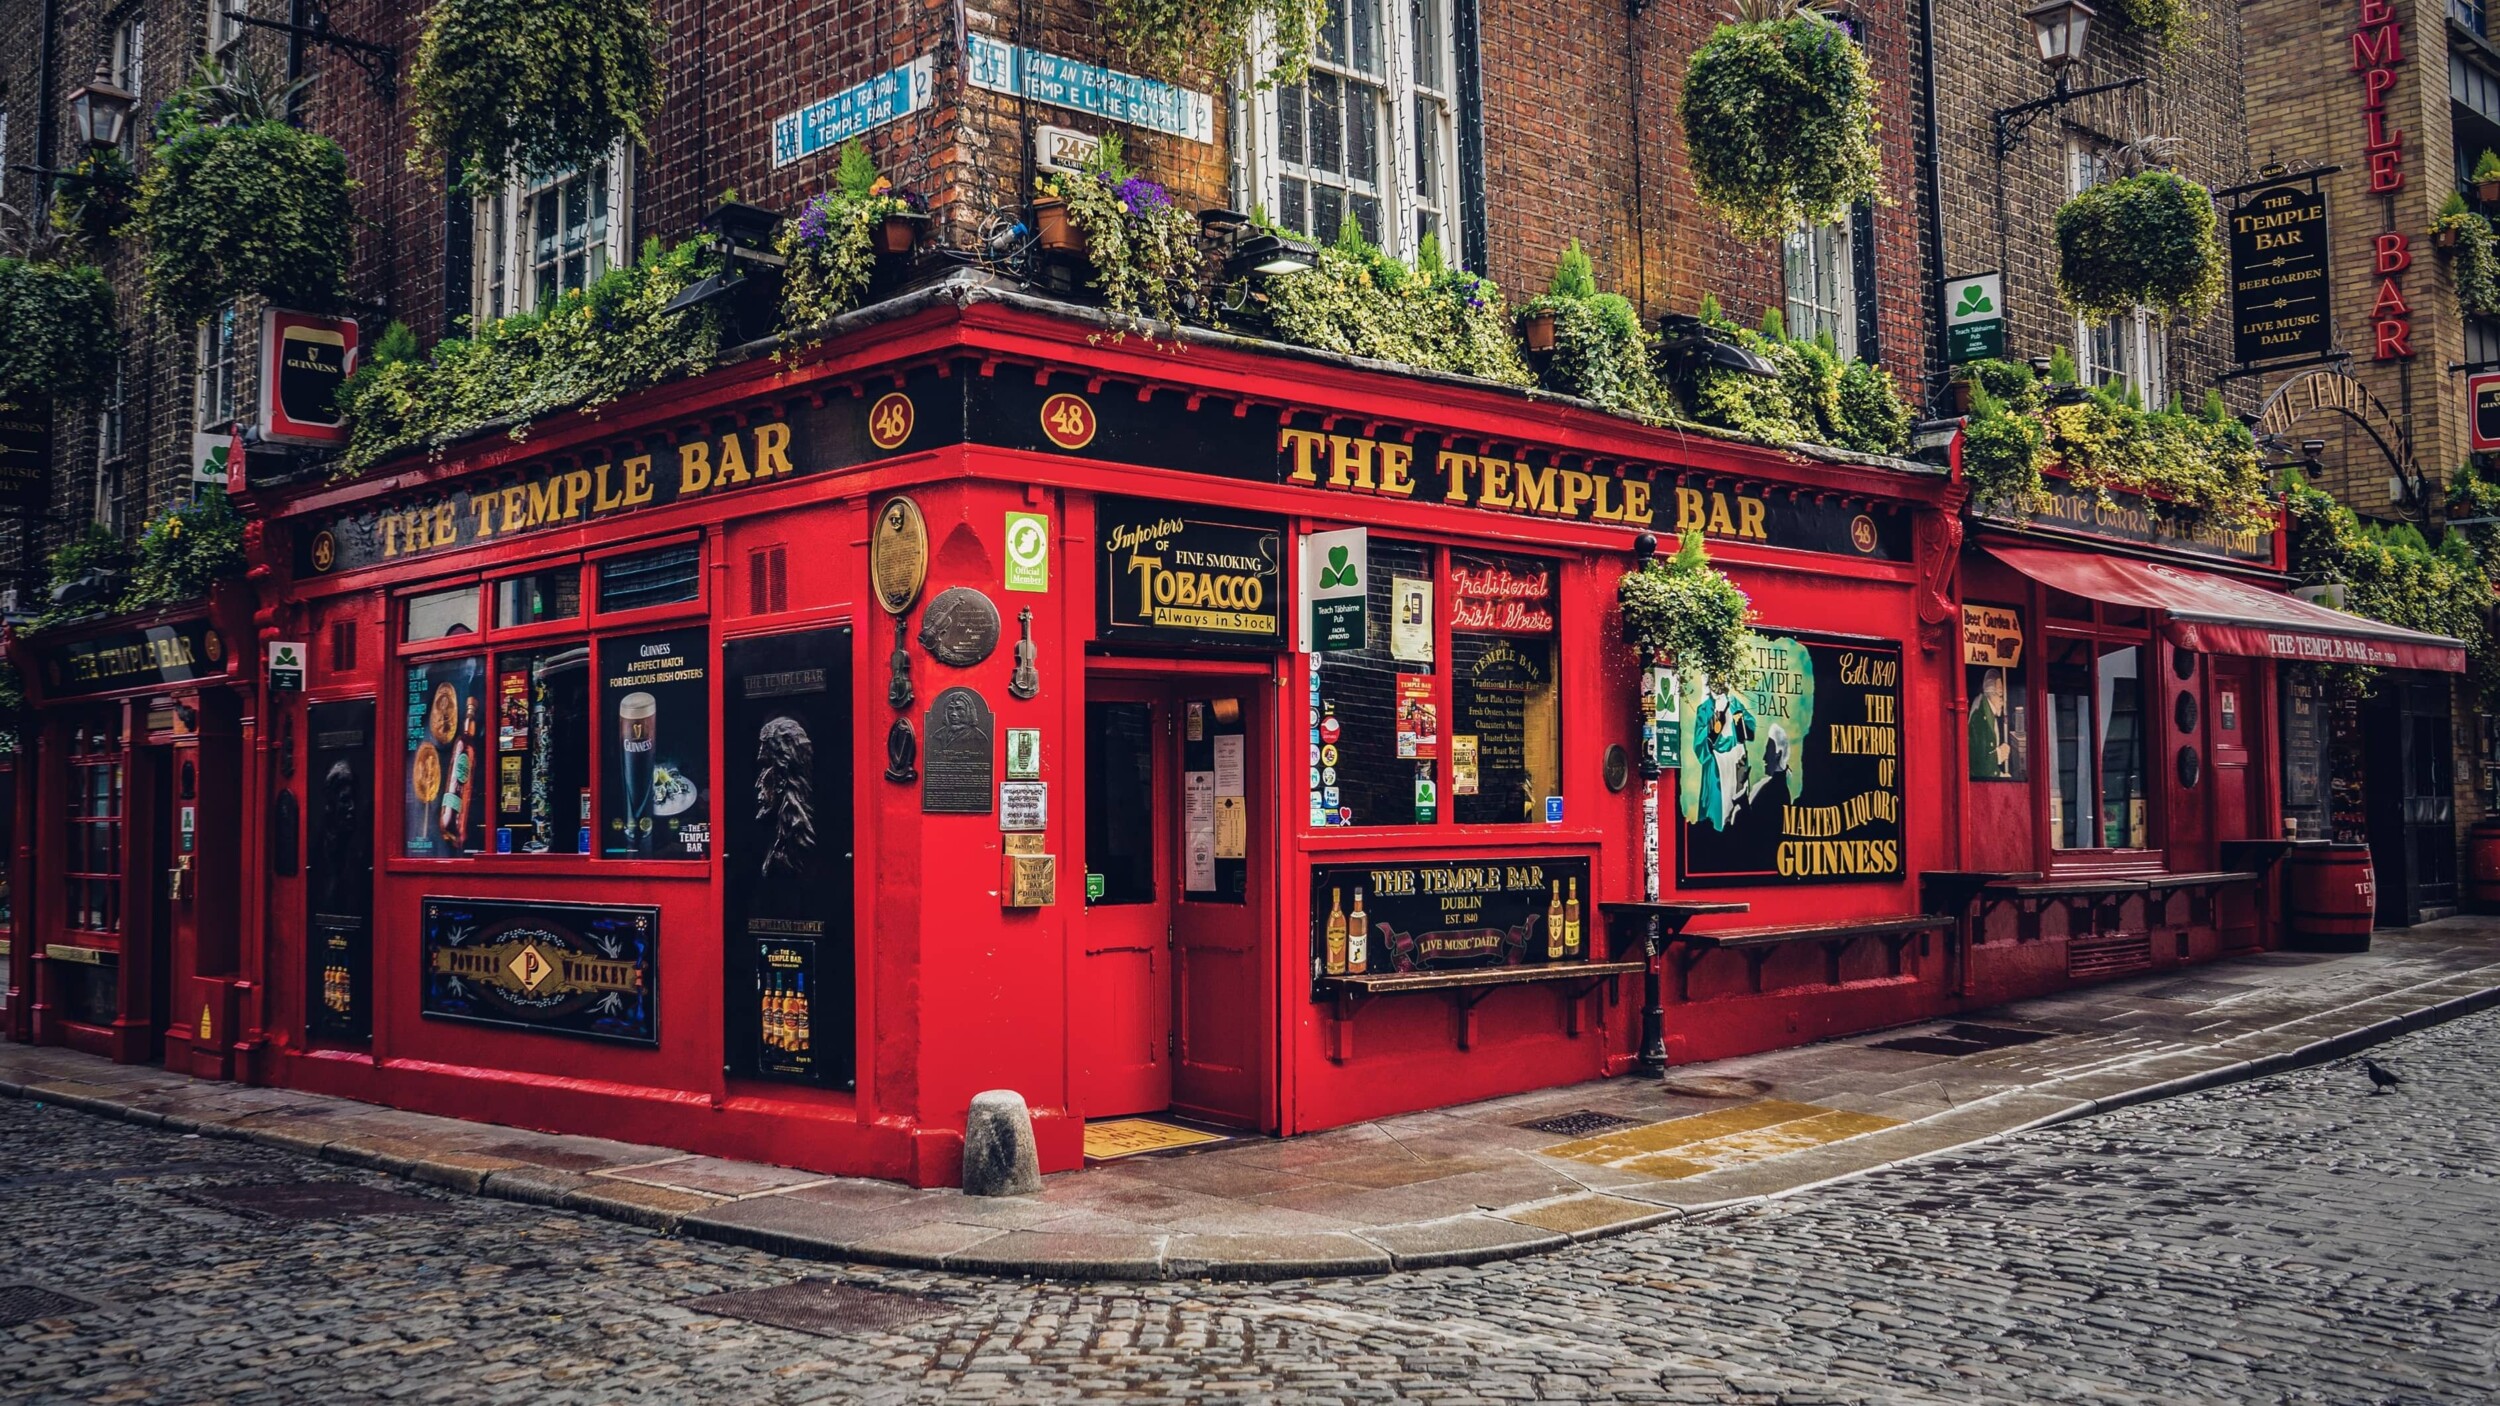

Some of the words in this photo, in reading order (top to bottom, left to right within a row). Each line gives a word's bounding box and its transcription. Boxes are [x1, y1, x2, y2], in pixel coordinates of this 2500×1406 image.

[916, 71, 927, 96] 2
[1060, 66, 1077, 82] AN
[1130, 102, 1178, 128] SOUTH
[819, 112, 862, 142] TEMPLE
[2262, 195, 2293, 209] THE
[2234, 205, 2323, 234] TEMPLE
[2256, 231, 2303, 251] BAR
[2239, 276, 2270, 291] BEER
[2271, 269, 2322, 286] GARDEN
[2369, 233, 2417, 361] BAR
[2243, 319, 2274, 334] LIVE
[2276, 313, 2320, 330] MUSIC
[2261, 330, 2302, 345] DAILY
[287, 359, 338, 373] GUINNESS
[2305, 373, 2375, 420] TEMPLE
[876, 403, 906, 438] 48
[1051, 401, 1084, 435] 48
[379, 501, 458, 557] THE
[471, 455, 654, 537] TEMPLE
[679, 422, 793, 494] BAR
[1282, 429, 1416, 498] THE
[1438, 450, 1654, 525] TEMPLE
[1676, 486, 1768, 543] BAR
[1106, 518, 1184, 555] Importers
[1854, 520, 1871, 546] 48
[316, 540, 330, 564] 48
[1156, 540, 1169, 551] OF
[1015, 567, 1040, 575] Official
[1176, 551, 1204, 566] FINE
[1206, 553, 1261, 571] SMOKING
[1013, 575, 1042, 584] Member
[1128, 555, 1262, 616] TOBACCO
[1451, 570, 1548, 595] Traditional
[1157, 609, 1208, 625] Always
[1216, 614, 1227, 626] in
[1234, 614, 1273, 630] Stock
[1318, 606, 1333, 615] Teach
[1334, 615, 1344, 623] Pub
[1450, 598, 1494, 627] Irish
[1502, 603, 1552, 629] Music
[1964, 609, 1982, 627] Beer
[1983, 611, 2011, 630] Garden
[1965, 628, 1996, 649] Smoking
[2268, 634, 2295, 654] THE
[2296, 636, 2344, 658] TEMPLE
[2344, 640, 2367, 660] BAR
[101, 641, 157, 676] TEMPLE
[158, 636, 195, 667] BAR
[640, 643, 671, 657] GUINNESS
[1757, 648, 1788, 670] THE
[1971, 647, 1989, 662] Area
[628, 661, 633, 672] A
[634, 659, 660, 671] PERFECT
[661, 657, 683, 669] MATCH
[1472, 649, 1516, 676] TEMPLE
[1520, 653, 1539, 679] BAR
[1872, 660, 1896, 687] 1840
[610, 677, 623, 688] FOR
[623, 673, 656, 686] DELICIOUS
[657, 672, 673, 683] IRISH
[675, 669, 703, 681] OYSTERS
[765, 672, 801, 688] TEMPLE
[804, 670, 823, 683] BAR
[1758, 694, 1790, 719] BAR
[1865, 694, 1895, 724] THE
[624, 738, 652, 752] GUINNESS
[1830, 725, 1896, 756] EMPEROR
[1879, 758, 1895, 787] OF
[1782, 804, 1841, 837] MALTED
[1842, 790, 1899, 831] LIQUORS
[679, 831, 709, 843] TEMPLE
[687, 842, 703, 852] BAR
[1777, 840, 1898, 877] GUINNESS
[1371, 870, 1415, 895] THE
[1421, 867, 1500, 894] TEMPLE
[1506, 865, 1545, 890] BAR
[1441, 896, 1481, 910] DUBLIN
[1445, 914, 1461, 924] EST.
[1463, 913, 1478, 924] 1840
[1420, 939, 1442, 952] LIVE
[1444, 938, 1470, 950] MUSIC
[1474, 936, 1500, 949] DAILY
[451, 952, 500, 974] POWERS
[524, 951, 539, 985] P
[563, 960, 628, 985] WHISKEY
[790, 955, 802, 963] BAR
